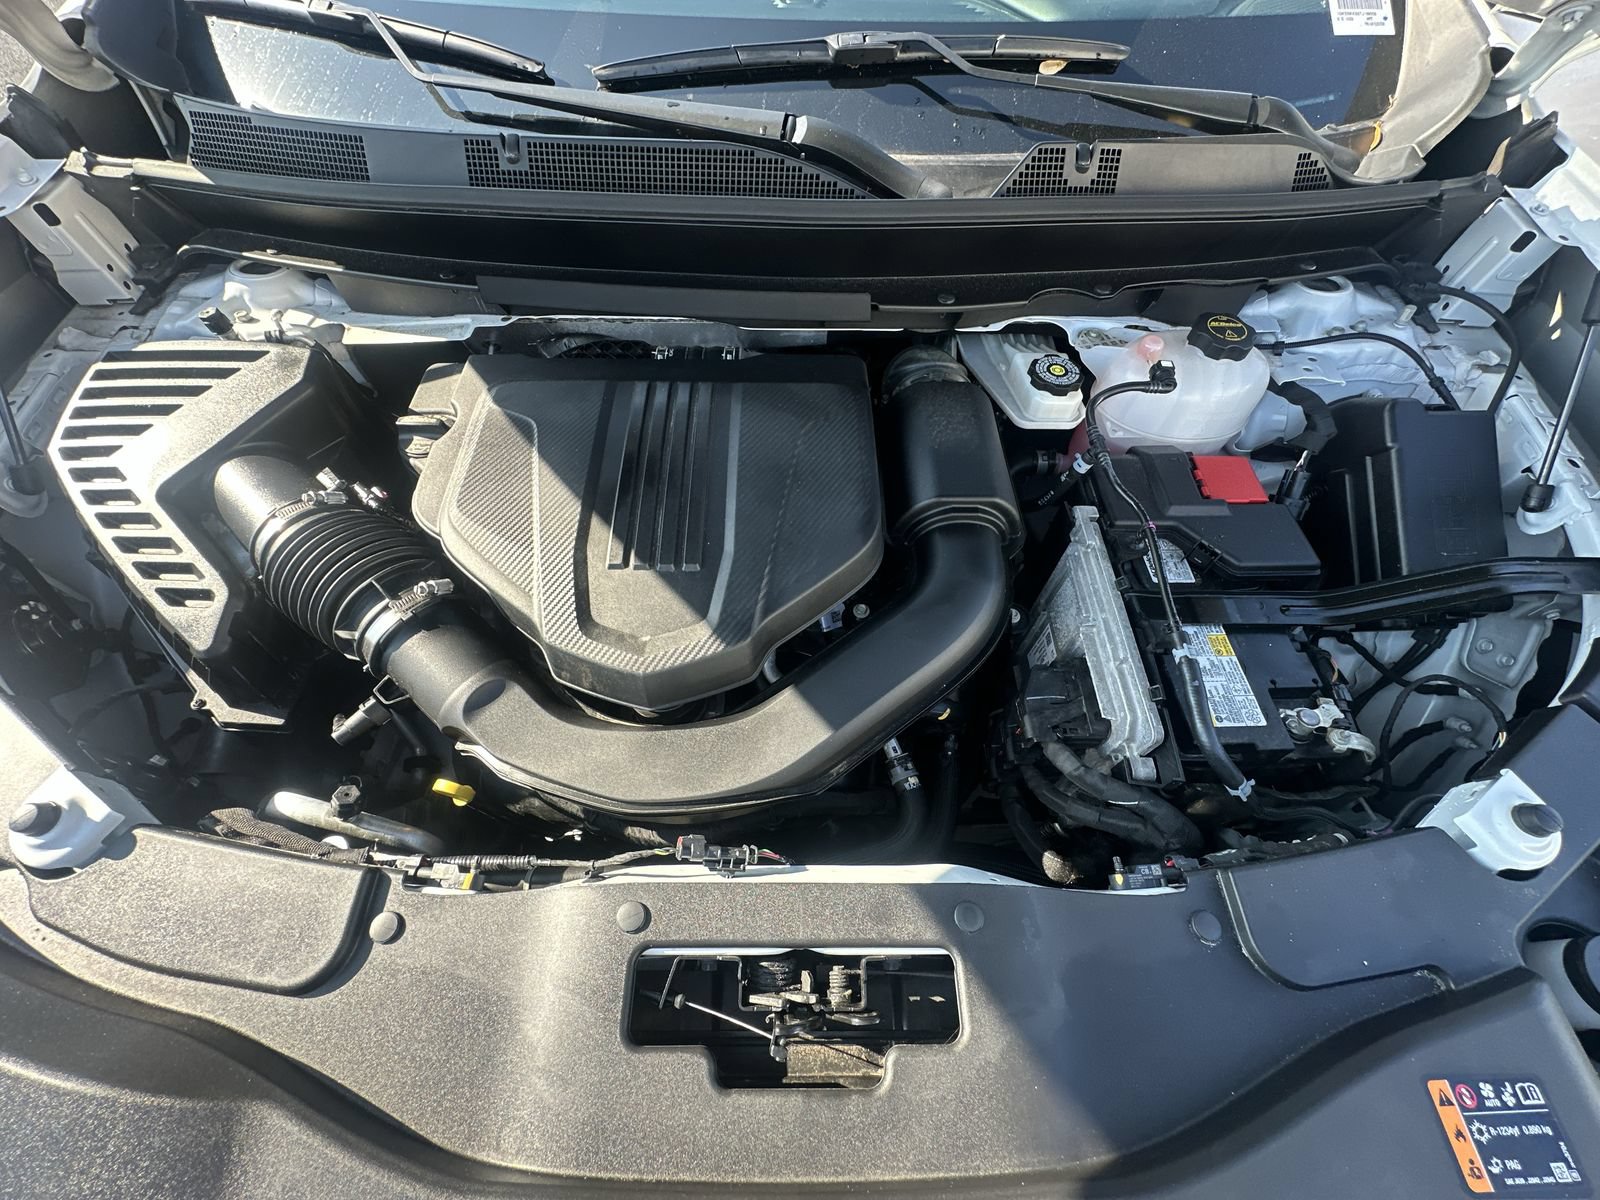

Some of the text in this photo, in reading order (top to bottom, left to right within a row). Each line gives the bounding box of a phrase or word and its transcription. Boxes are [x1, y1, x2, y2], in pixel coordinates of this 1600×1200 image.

[1485, 1099, 1501, 1107] AUTO
[1488, 1125, 1520, 1138] R-1234yf
[1540, 1124, 1553, 1136] kg
[1505, 1159, 1522, 1171] PAG
